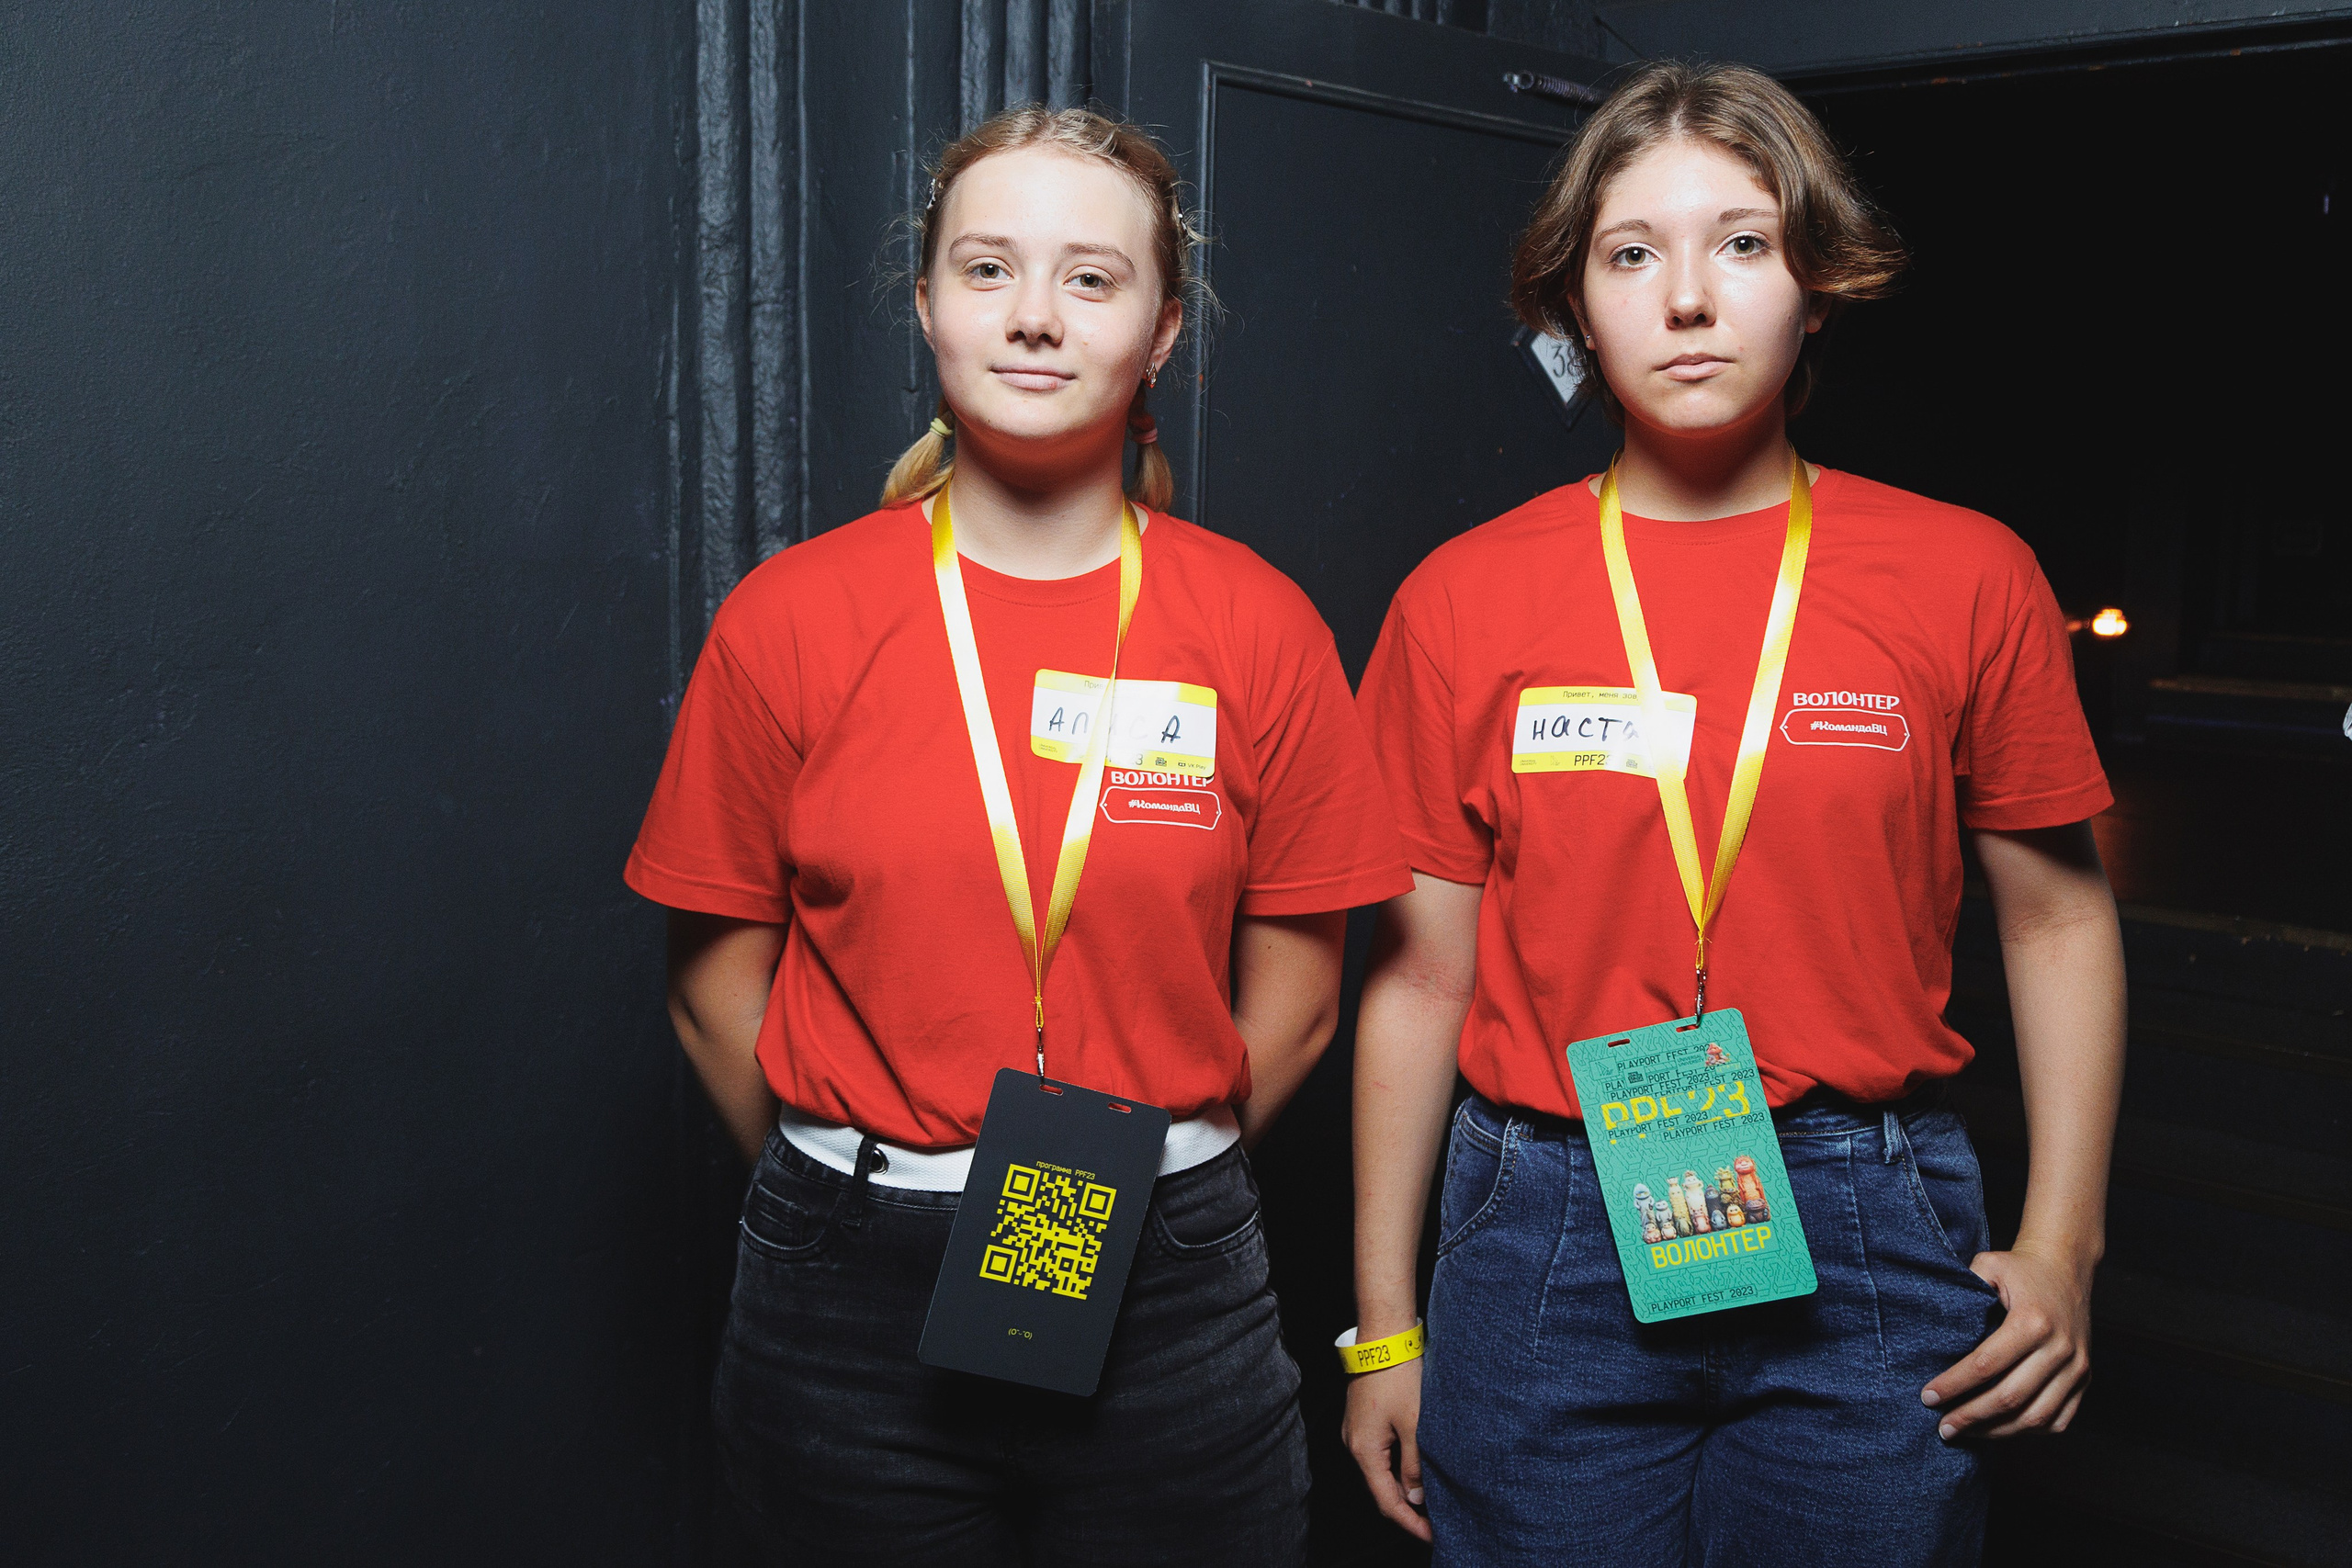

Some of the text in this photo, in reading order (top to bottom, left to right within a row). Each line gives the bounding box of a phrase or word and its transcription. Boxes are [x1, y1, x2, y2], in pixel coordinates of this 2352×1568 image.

[1792, 691, 1900, 710] ВОЛОНТЕР
[1810, 721, 1888, 736] #КомандаВЦ
[1128, 799, 1201, 815] #КомандаВЦ
[1731, 1069, 1755, 1081] 2023
[1611, 1073, 1710, 1100] PLAYPORT FEST 2023
[1608, 1111, 1708, 1139] PLAYPORT FEST 2023
[1664, 1112, 1765, 1141] PLAYPORT FEST 2023
[1035, 1160, 1096, 1180] программа PPF23
[1650, 1225, 1771, 1269] ВОЛОНТЕР
[1651, 1285, 1754, 1313] PLAYPORT FEST 2023
[1357, 1345, 1391, 1367] PPF23
